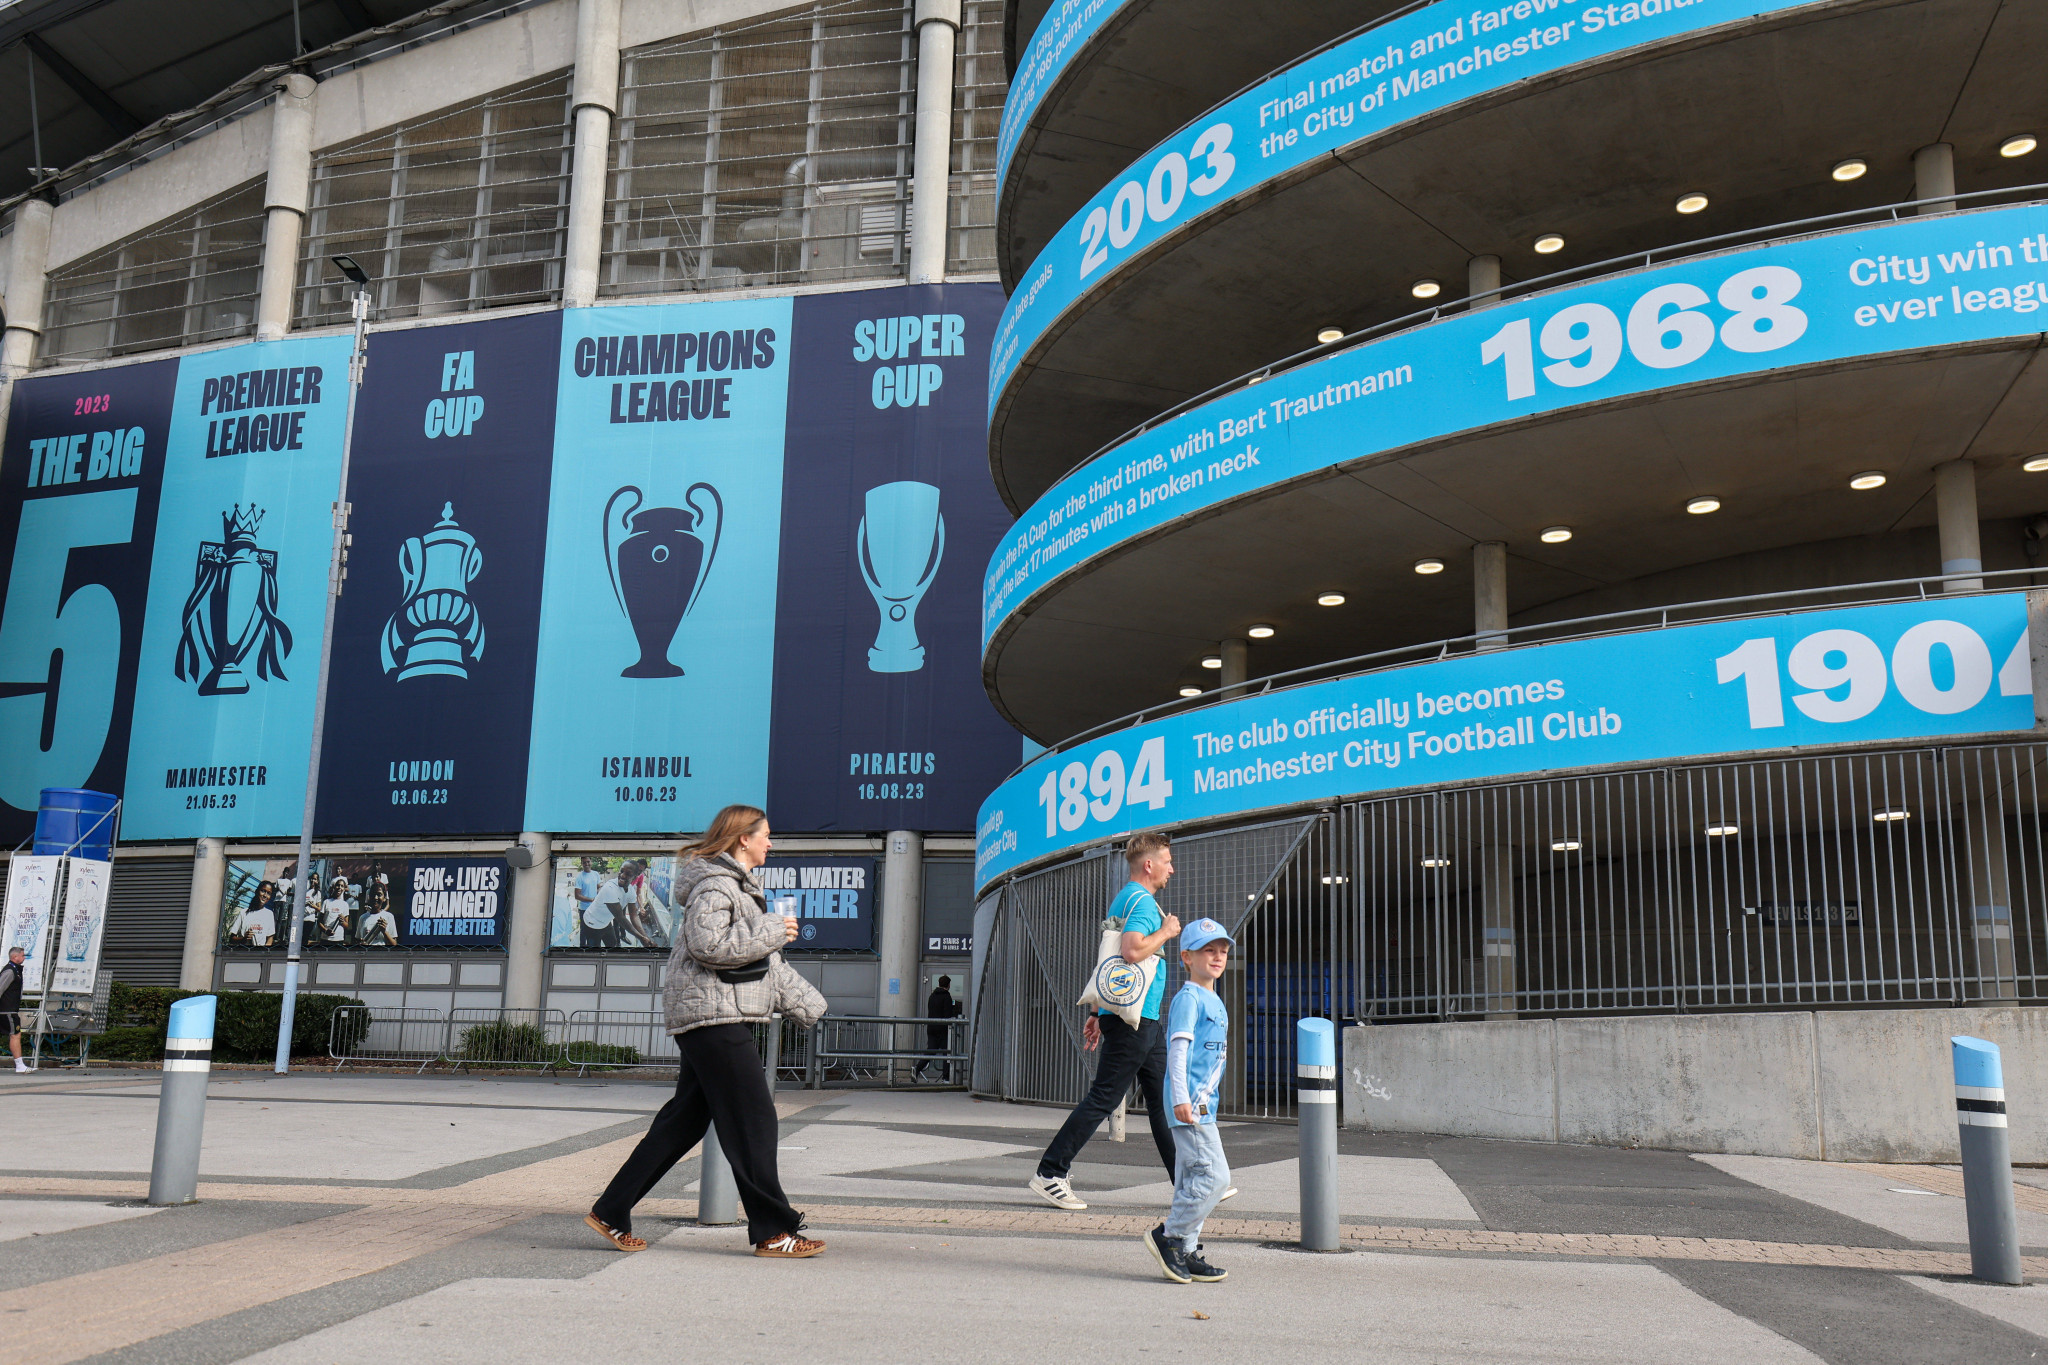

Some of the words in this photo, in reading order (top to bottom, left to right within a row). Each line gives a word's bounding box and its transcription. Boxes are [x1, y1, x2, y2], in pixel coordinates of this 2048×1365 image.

[1035, 13, 1083, 86] 100-point
[1036, 17, 1061, 61] City's
[1259, 81, 1315, 129] Final
[1320, 45, 1404, 98] match
[1410, 18, 1464, 60] and
[1468, 0, 1579, 37] farew
[1259, 128, 1298, 158] the
[1303, 101, 1354, 137] City
[1360, 82, 1387, 113] of
[1392, 20, 1576, 101] Manchester
[1079, 122, 1236, 281] 2003
[1849, 255, 1931, 287] City
[1937, 240, 2014, 274] win
[1015, 293, 1029, 323] late
[1029, 263, 1053, 306] goals
[1854, 295, 1944, 327] ever
[574, 327, 776, 378] CHAMPIONS
[852, 314, 966, 363] SUPER
[1480, 266, 1809, 402] 1968
[200, 366, 324, 417] PREMIER
[440, 350, 475, 393] FA
[871, 364, 943, 410] CUP
[74, 394, 111, 416] 2023
[424, 395, 485, 439] CUP
[609, 378, 733, 424] LEAGUE
[27, 433, 88, 488] THE
[86, 426, 146, 481] BIG
[205, 412, 306, 459] LEAGUE
[1005, 547, 1017, 569] the
[1017, 532, 1029, 557] FA
[1029, 519, 1048, 546] Cup
[1048, 507, 1065, 531] for
[1066, 495, 1087, 518] the
[1089, 467, 1123, 505] third
[1125, 453, 1168, 485] time,
[1170, 428, 1214, 463] with
[1219, 408, 1267, 445] Bert
[1270, 364, 1413, 424] Trautmann
[1003, 577, 1014, 600] the
[1014, 560, 1029, 589] last
[1030, 547, 1041, 573] 17
[1042, 522, 1089, 565] minutes
[1090, 501, 1124, 534] with
[1126, 498, 1137, 516] a
[1140, 470, 1204, 510] broken
[1208, 445, 1261, 482] neck
[0, 487, 139, 812] 5
[1193, 732, 1234, 758] The
[1239, 719, 1289, 750] club
[1294, 698, 1410, 739] officially
[1417, 680, 1565, 719] becomes
[389, 759, 455, 782] LONDON
[601, 756, 692, 779] ISTANBUL
[850, 752, 936, 776] PIRAEUS
[1195, 752, 1339, 794] Manchester
[1344, 739, 1401, 769] City
[1408, 717, 1535, 759] Football
[1542, 707, 1622, 741] Club
[165, 765, 267, 789] MANCHESTER
[391, 788, 448, 805] 03.06.23
[614, 786, 677, 802] 10.06.23
[858, 782, 924, 800] 16.08.23
[1039, 736, 1173, 838] 1894
[185, 793, 237, 810] 21.05.23
[995, 810, 1003, 833] go
[1002, 830, 1017, 852] City
[413, 867, 454, 891] 50K+
[456, 866, 500, 891] LIVES
[800, 866, 865, 889] WATER
[411, 890, 498, 918] CHANGED
[1768, 906, 1812, 921] LVLS
[409, 918, 432, 936] FOR
[432, 918, 454, 936] THE
[454, 918, 496, 936] BETTER
[942, 937, 960, 945] STAIRS
[1103, 959, 1127, 971] MANCHEST
